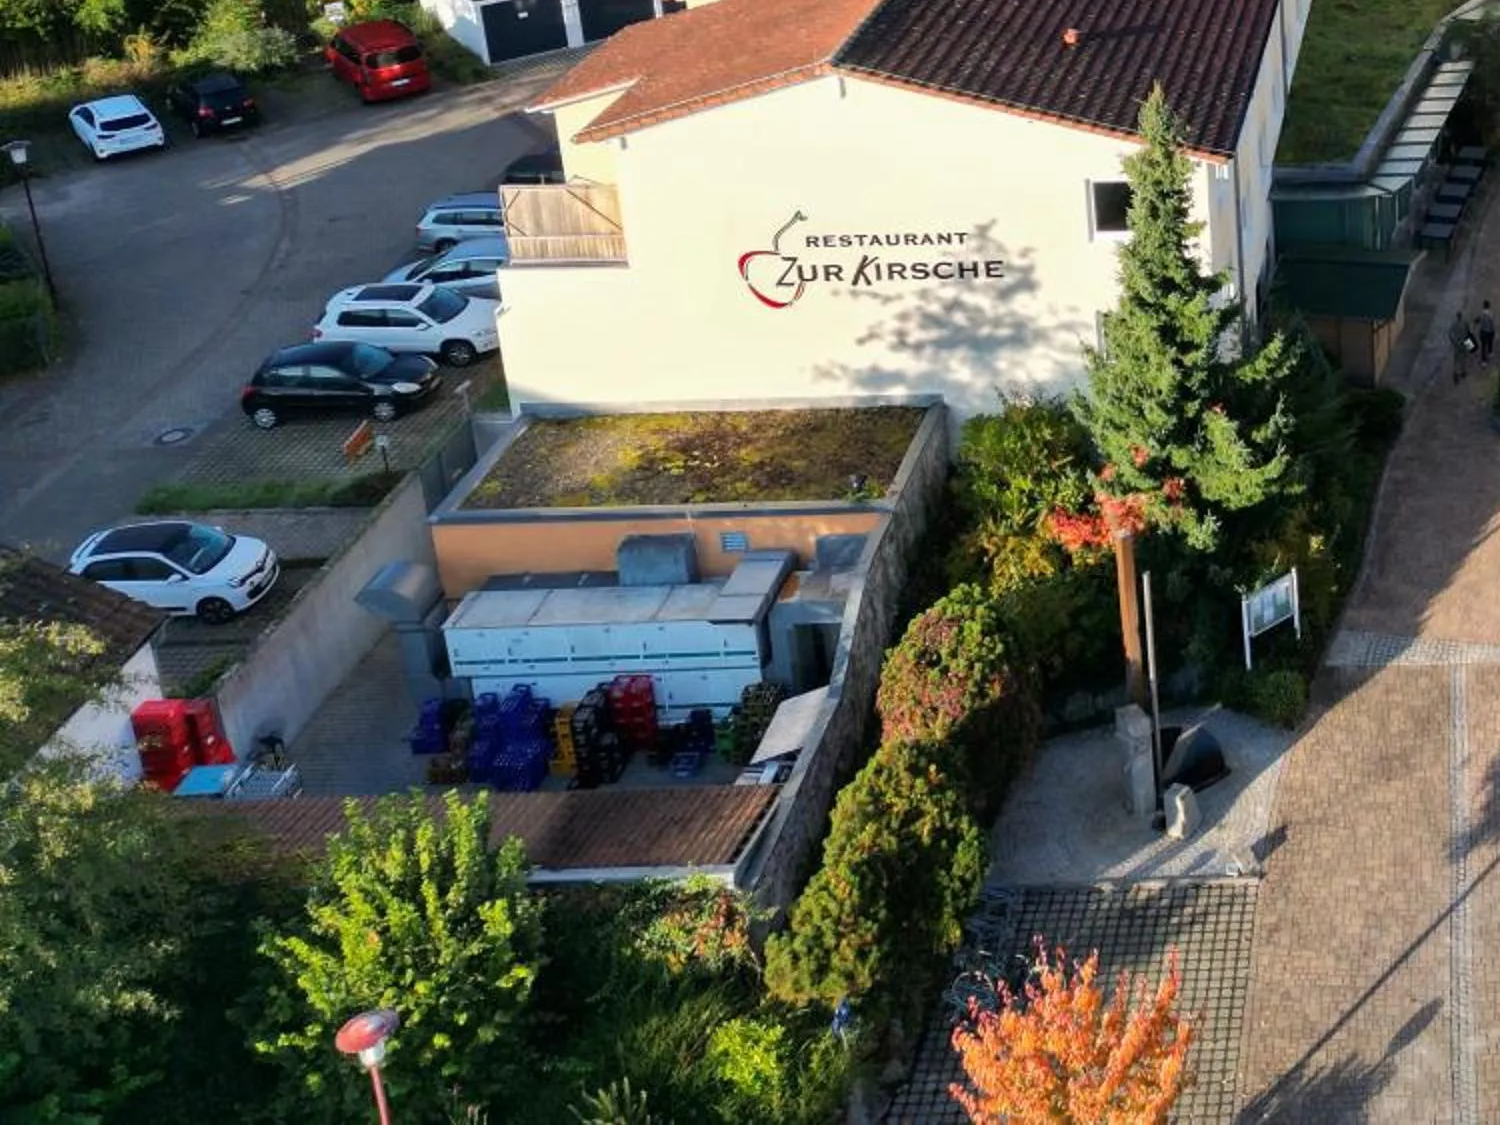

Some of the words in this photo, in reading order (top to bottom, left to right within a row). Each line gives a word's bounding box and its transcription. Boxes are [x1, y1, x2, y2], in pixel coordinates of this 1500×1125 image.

[805, 232, 969, 248] RESTAURANT
[776, 256, 845, 287] ZUR
[851, 254, 1006, 287] KIRSCHE
